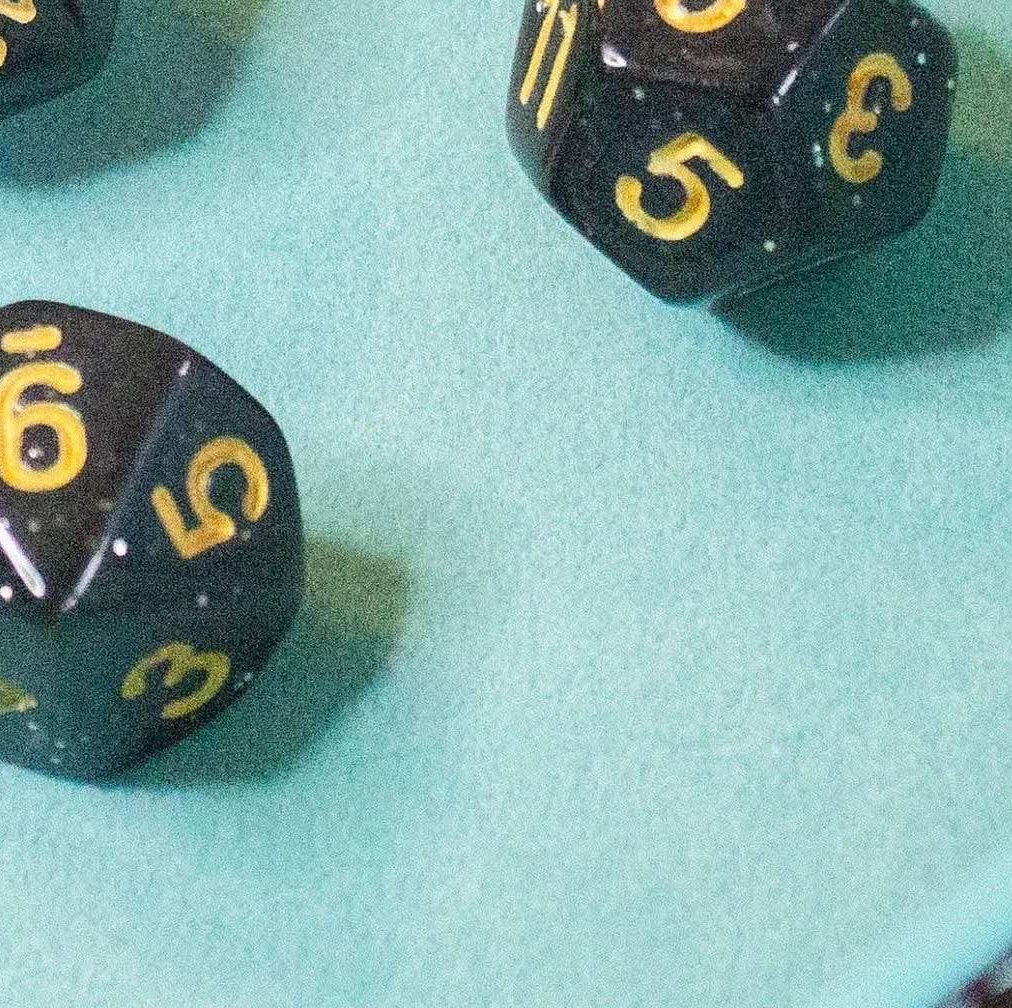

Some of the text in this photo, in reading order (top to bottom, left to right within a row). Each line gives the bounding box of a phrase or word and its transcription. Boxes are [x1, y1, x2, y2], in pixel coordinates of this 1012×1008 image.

[828, 53, 914, 184] 3
[614, 132, 746, 242] 5
[150, 436, 270, 561] 5
[121, 641, 231, 720] 3
